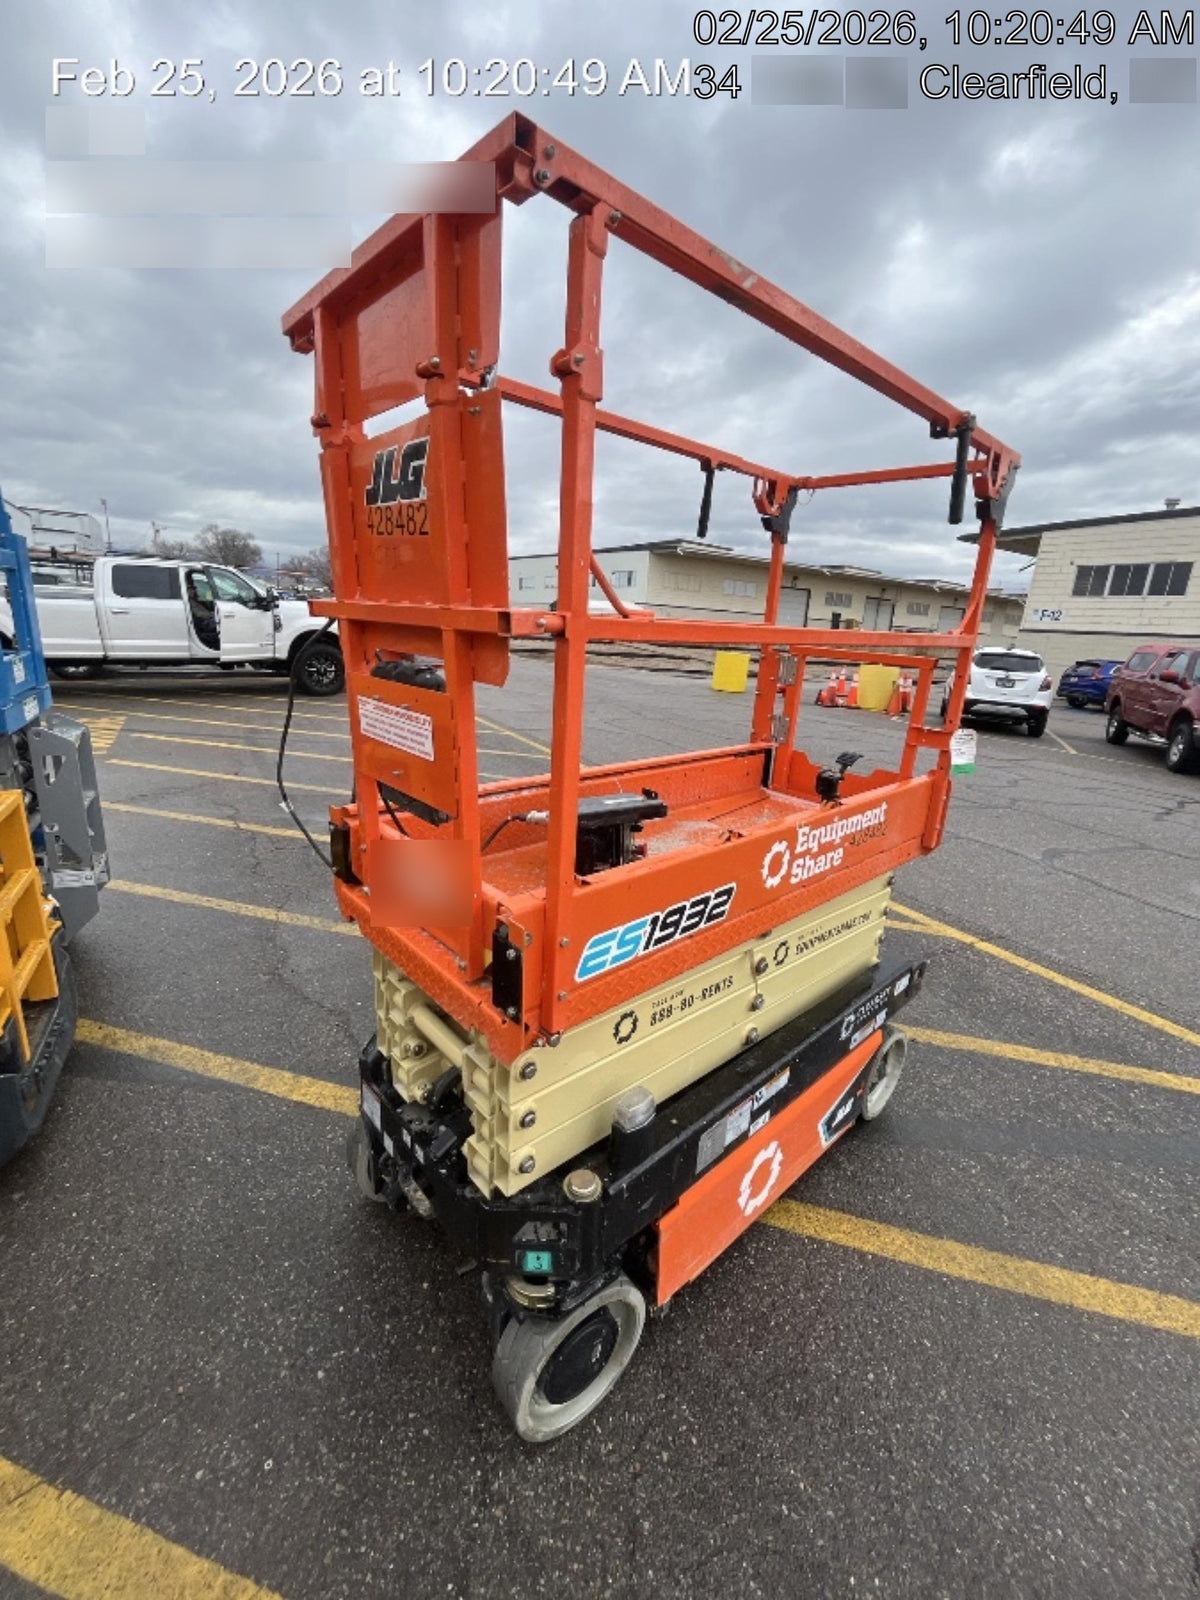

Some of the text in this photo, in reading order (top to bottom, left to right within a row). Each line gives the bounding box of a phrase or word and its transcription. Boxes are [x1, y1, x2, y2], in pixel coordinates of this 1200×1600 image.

[364, 435, 430, 507] JLG
[367, 503, 429, 536] 428482
[794, 800, 888, 854] Equipment
[789, 847, 844, 884] Share
[574, 881, 737, 984] ES1932
